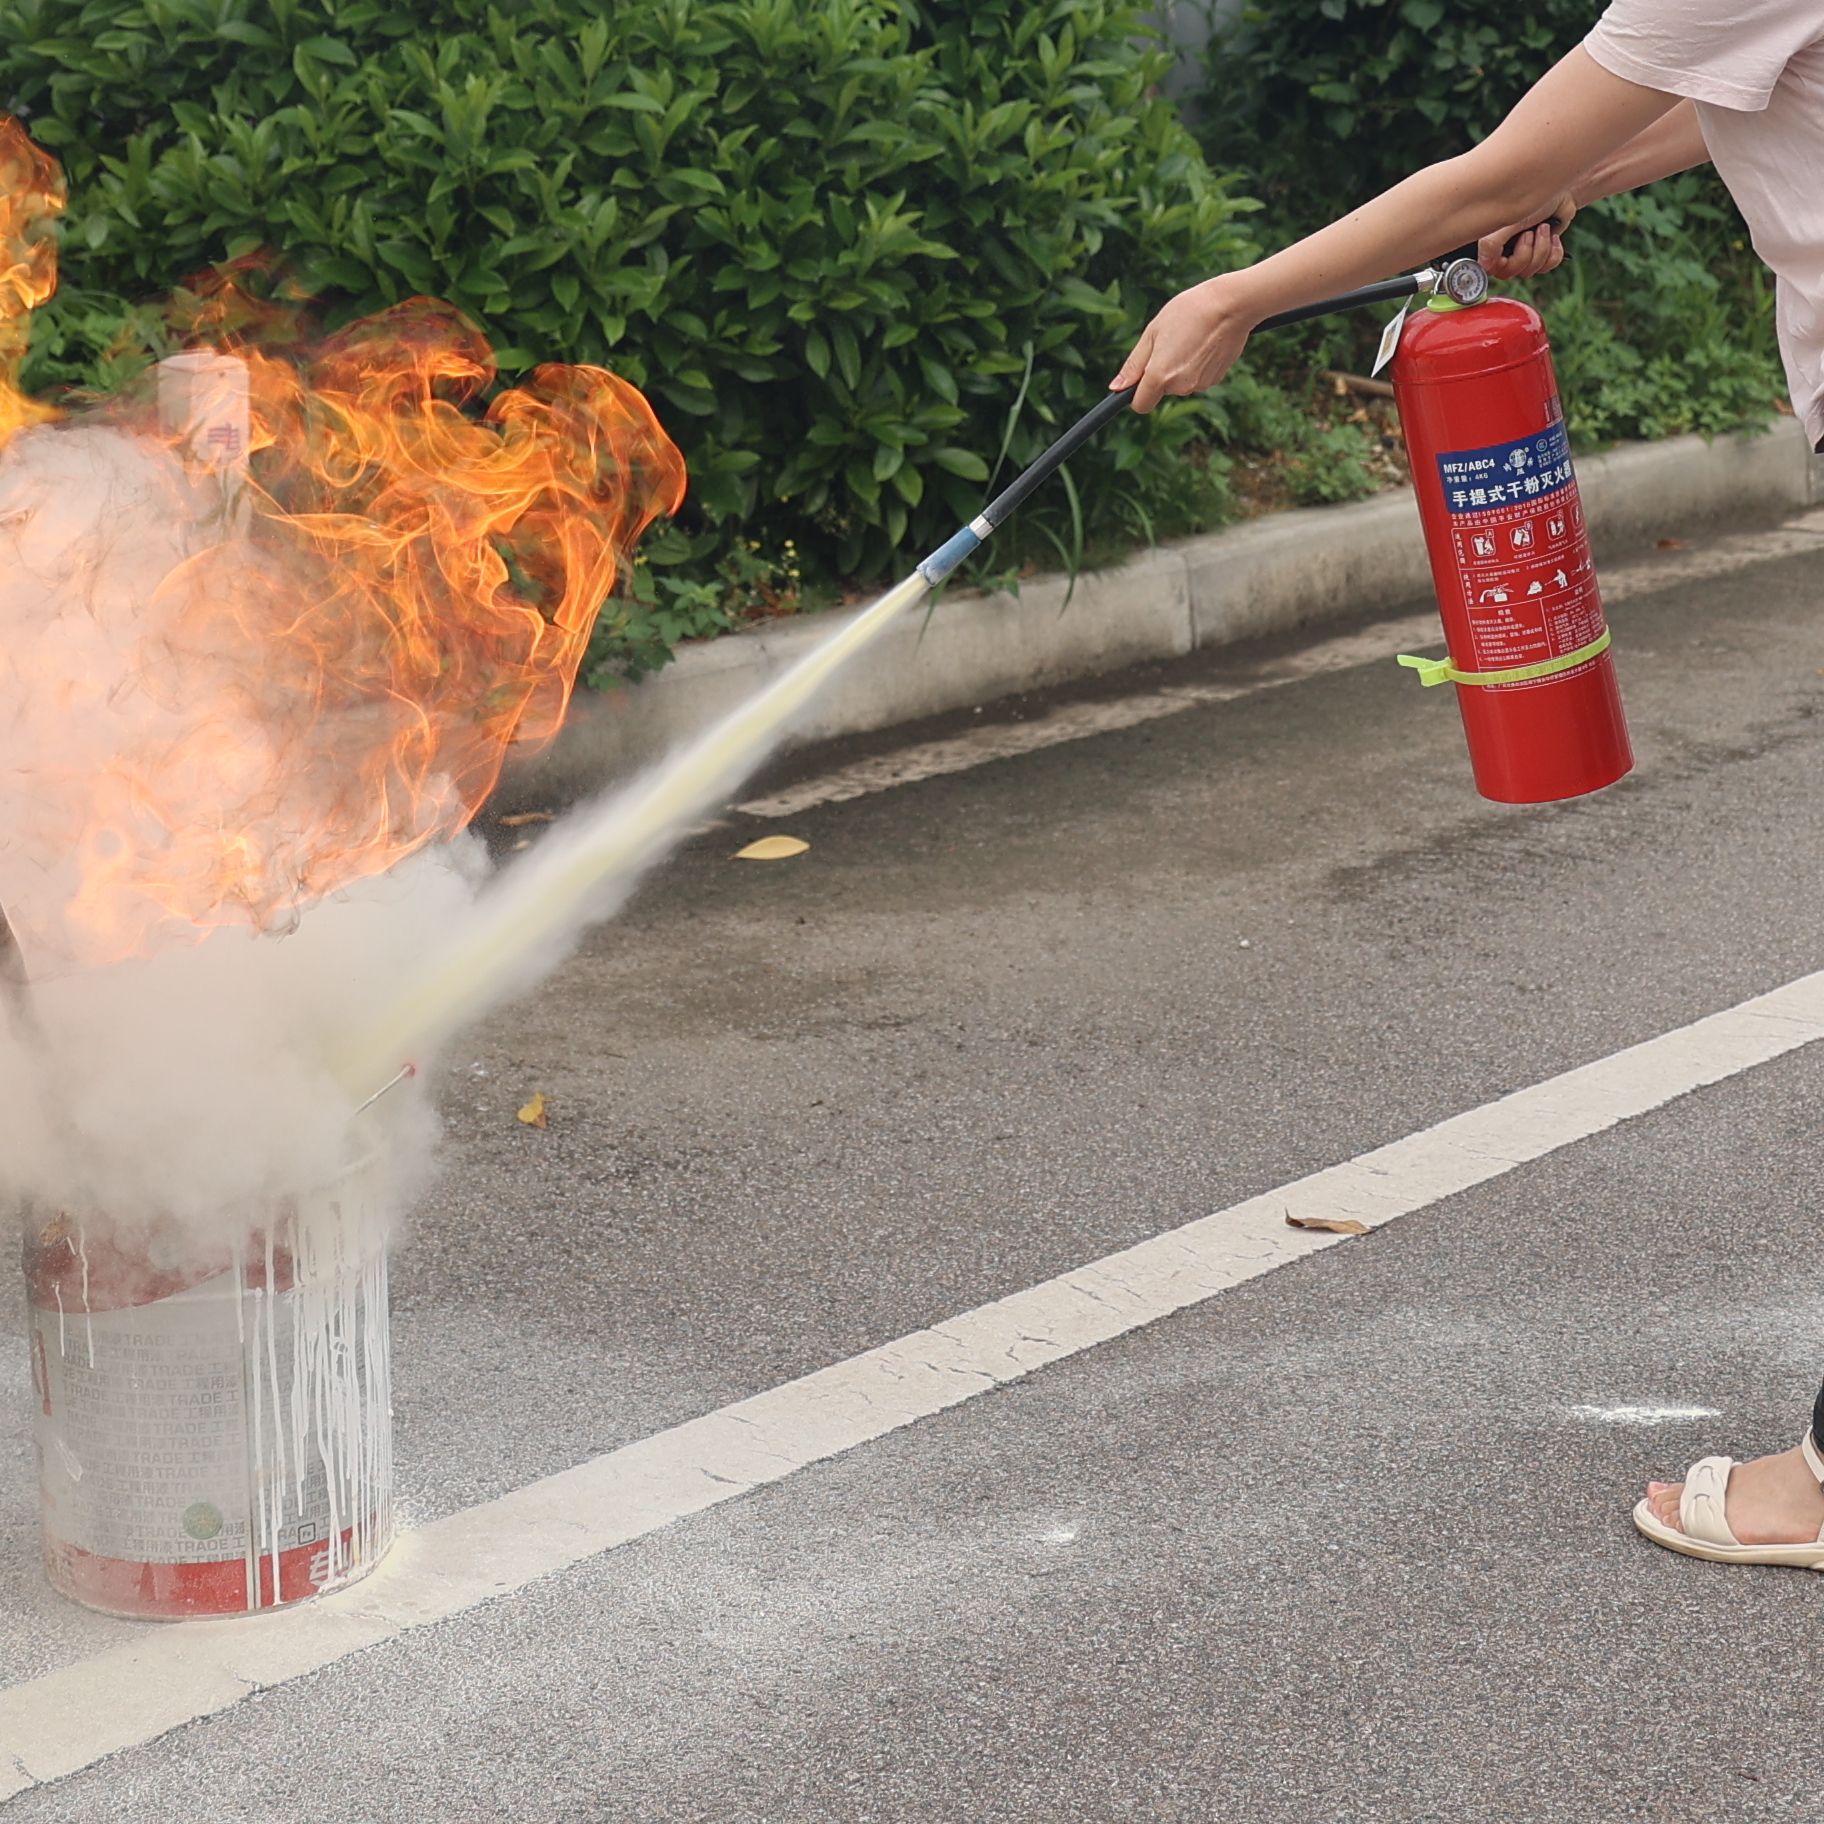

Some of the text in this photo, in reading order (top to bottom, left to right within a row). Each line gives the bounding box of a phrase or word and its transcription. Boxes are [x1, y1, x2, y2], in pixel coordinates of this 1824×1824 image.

[1443, 458, 1495, 474] MFZ/ABC4
[1452, 459, 1572, 508] 手提式干粉灭火器
[150, 1364, 204, 1376] TRADE
[127, 1378, 177, 1390] TRADE
[181, 1375, 238, 1389] 工程用漆
[70, 1385, 108, 1401] TRADE
[168, 1389, 222, 1405] TRADE
[128, 1406, 179, 1419] TRADE
[186, 1404, 239, 1419] 工程用漆
[154, 1422, 206, 1434] TRADE
[167, 1435, 223, 1449] TRADE
[132, 1452, 184, 1464] TRADE
[155, 1466, 209, 1478] TRADE
[135, 1495, 186, 1508] TRADE
[175, 1538, 229, 1552] TRADE
[233, 1537, 246, 1548] 工
